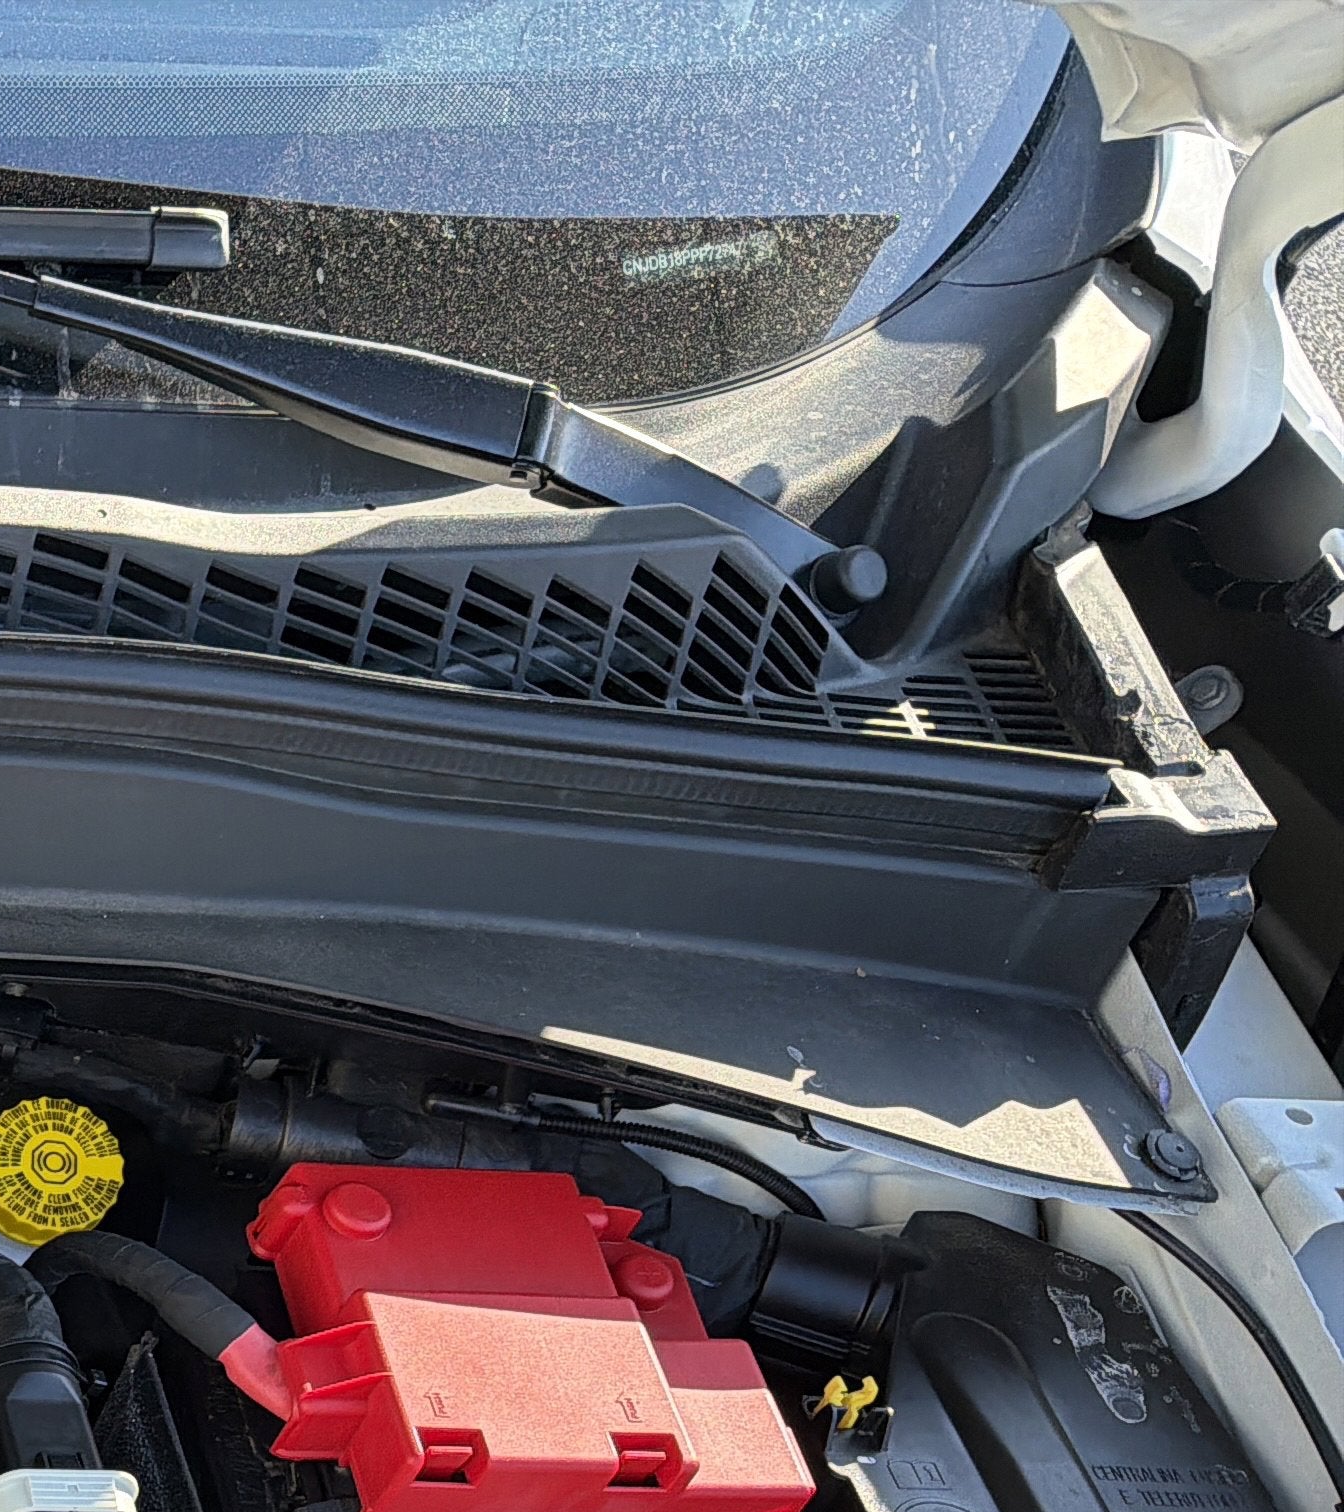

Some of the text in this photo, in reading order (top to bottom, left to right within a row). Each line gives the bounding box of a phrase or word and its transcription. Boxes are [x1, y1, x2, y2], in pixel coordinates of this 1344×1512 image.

[0, 1103, 29, 1129] NETTOYER
[30, 1098, 41, 1111] CE
[45, 1098, 80, 1113] BOUCHON
[14, 1116, 30, 1131] QUE
[2, 1174, 17, 1188] CAP
[11, 1187, 40, 1212] BEFORE
[81, 1191, 98, 1207] USE
[92, 1177, 107, 1196] ONLY
[3, 1195, 27, 1217] FLUID
[26, 1210, 49, 1226] FROM
[59, 1211, 90, 1228] SEALED
[89, 1179, 120, 1216] CONTAINER
[46, 1192, 72, 1204] CLEAN
[71, 1175, 95, 1199] FILLER
